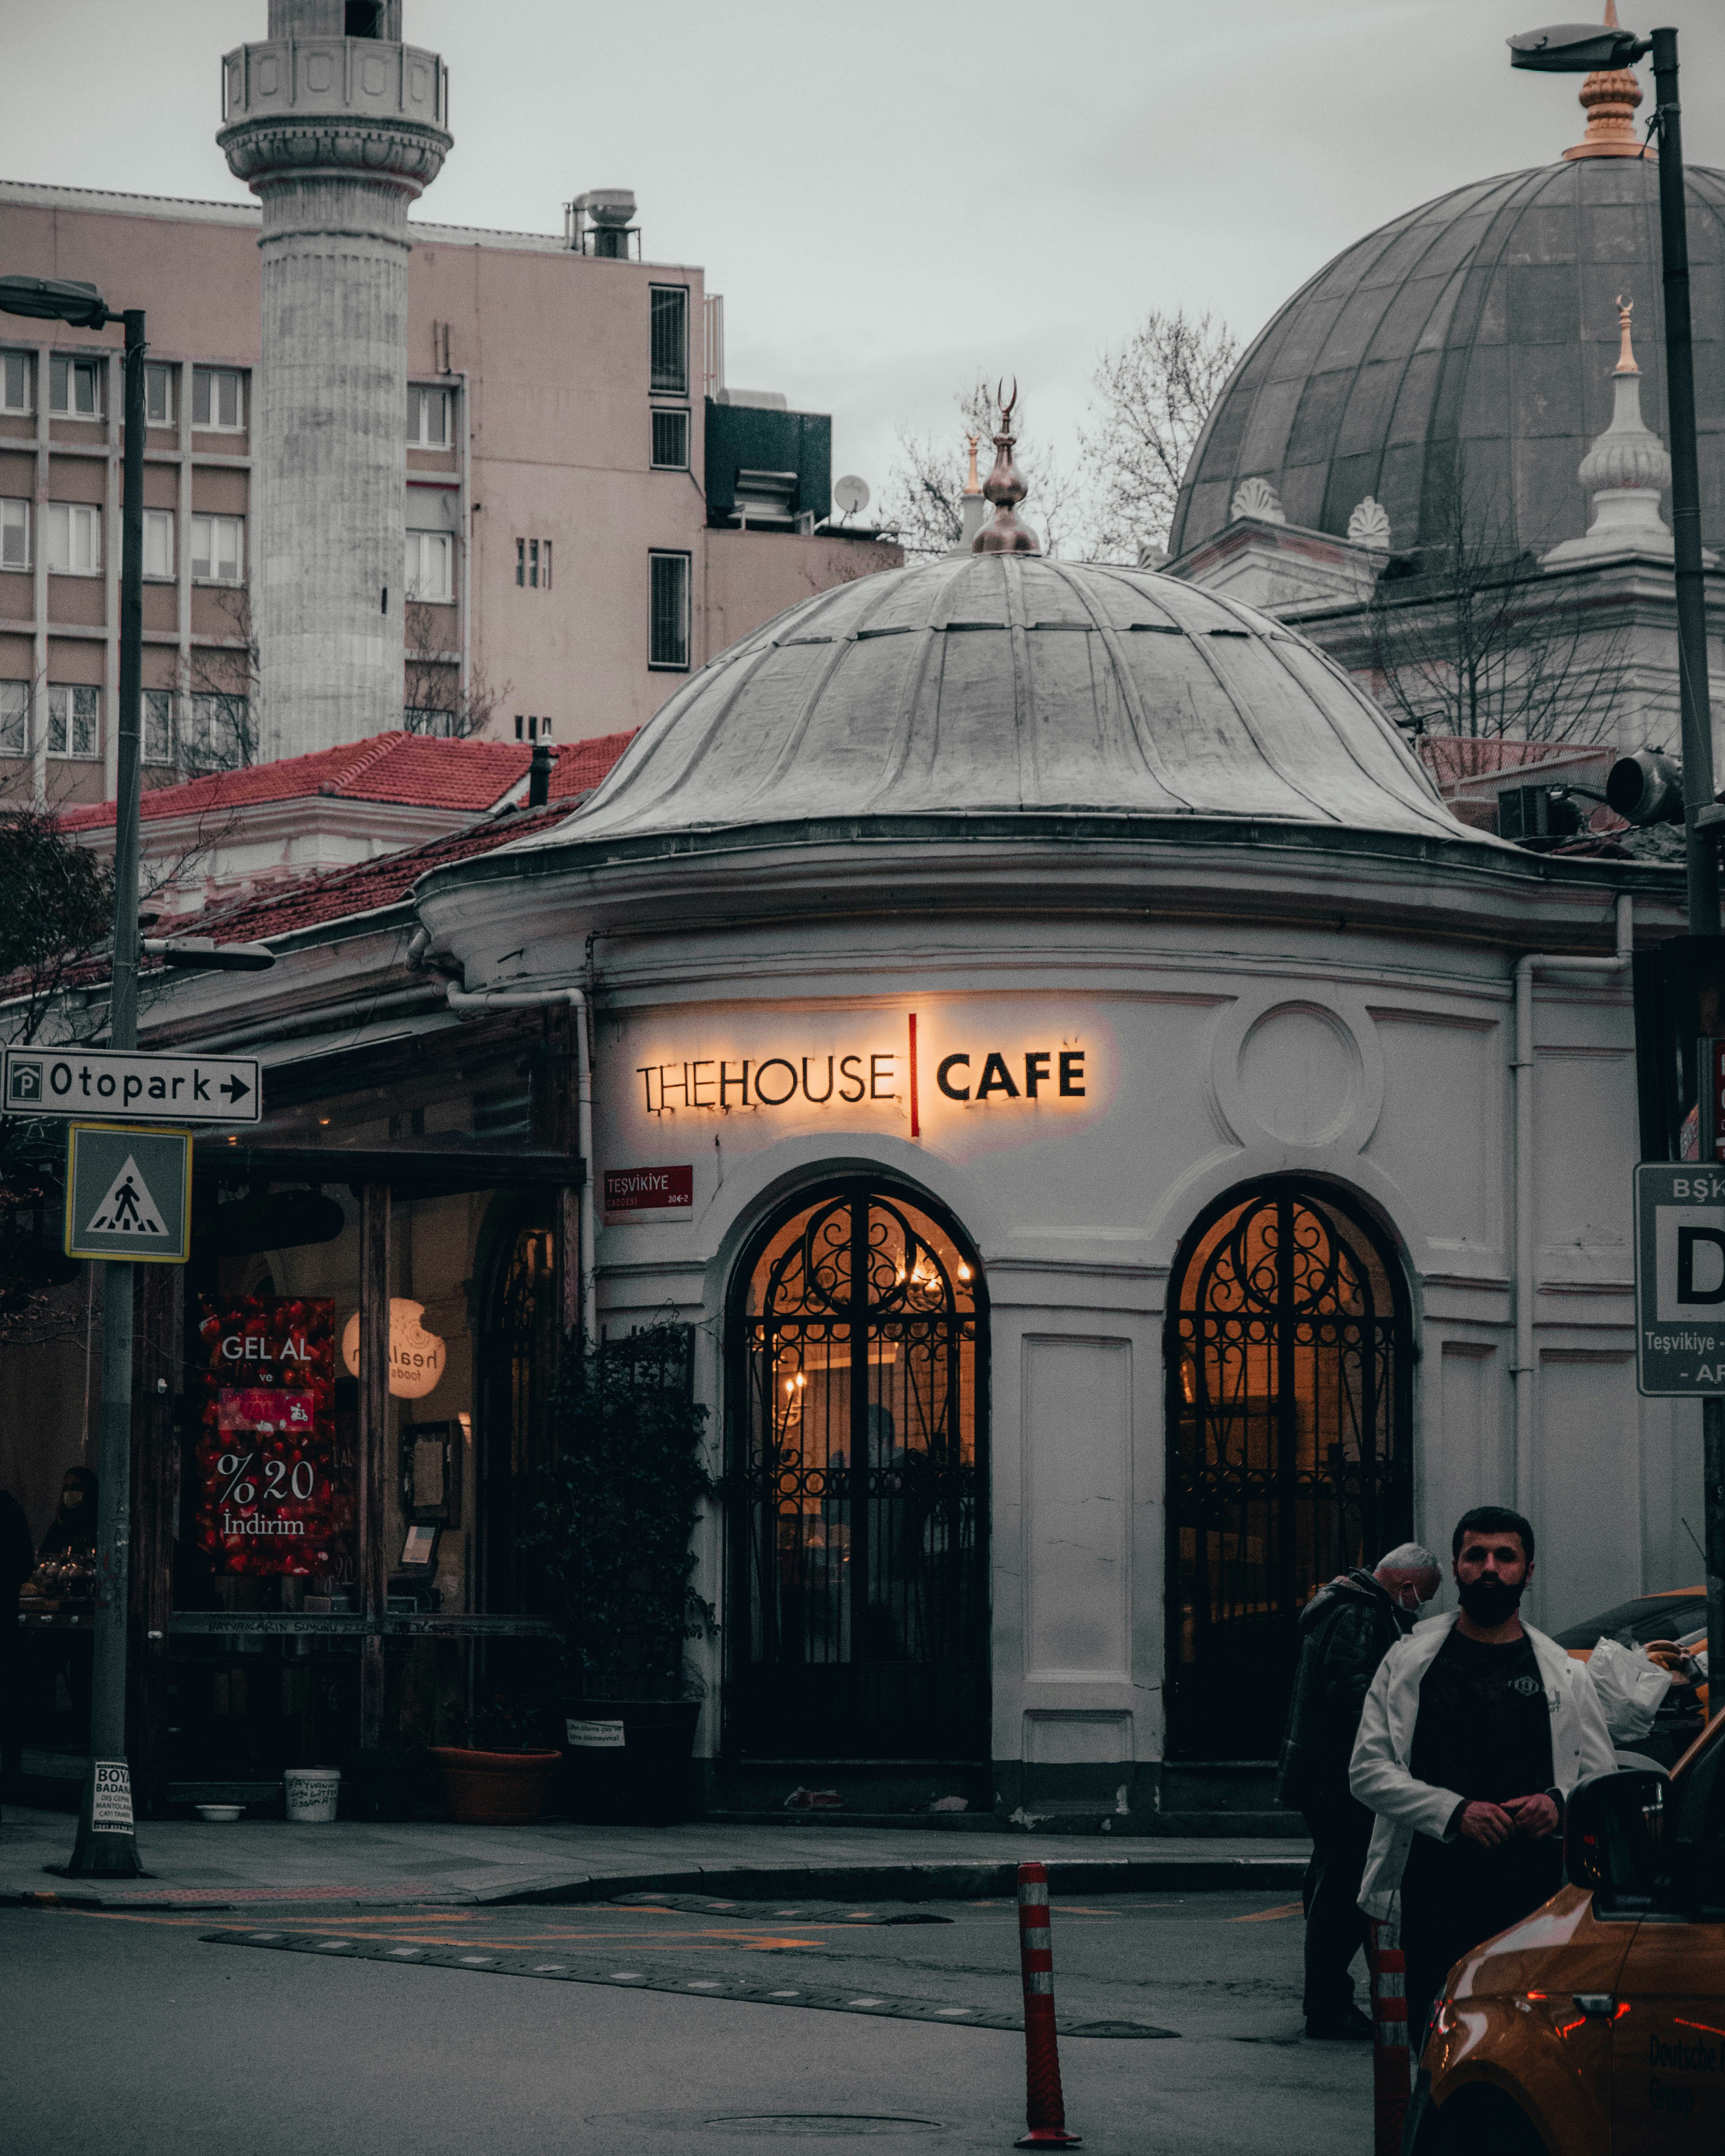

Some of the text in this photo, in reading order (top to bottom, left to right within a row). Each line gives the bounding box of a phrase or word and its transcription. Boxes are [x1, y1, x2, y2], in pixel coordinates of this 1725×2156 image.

[51, 1062, 210, 1107] Otopark
[937, 1052, 1085, 1100] CAFE
[608, 1173, 669, 1195] TEŞVİKİYE
[222, 1336, 312, 1360] GEL AL
[1645, 1331, 1715, 1355] Teşvikiye
[259, 1374, 273, 1382] ve
[217, 1452, 314, 1504] %20
[223, 1508, 305, 1535] İndirim
[1650, 2034, 1716, 2073] Deutsche
[1649, 2077, 1694, 2124] Group
